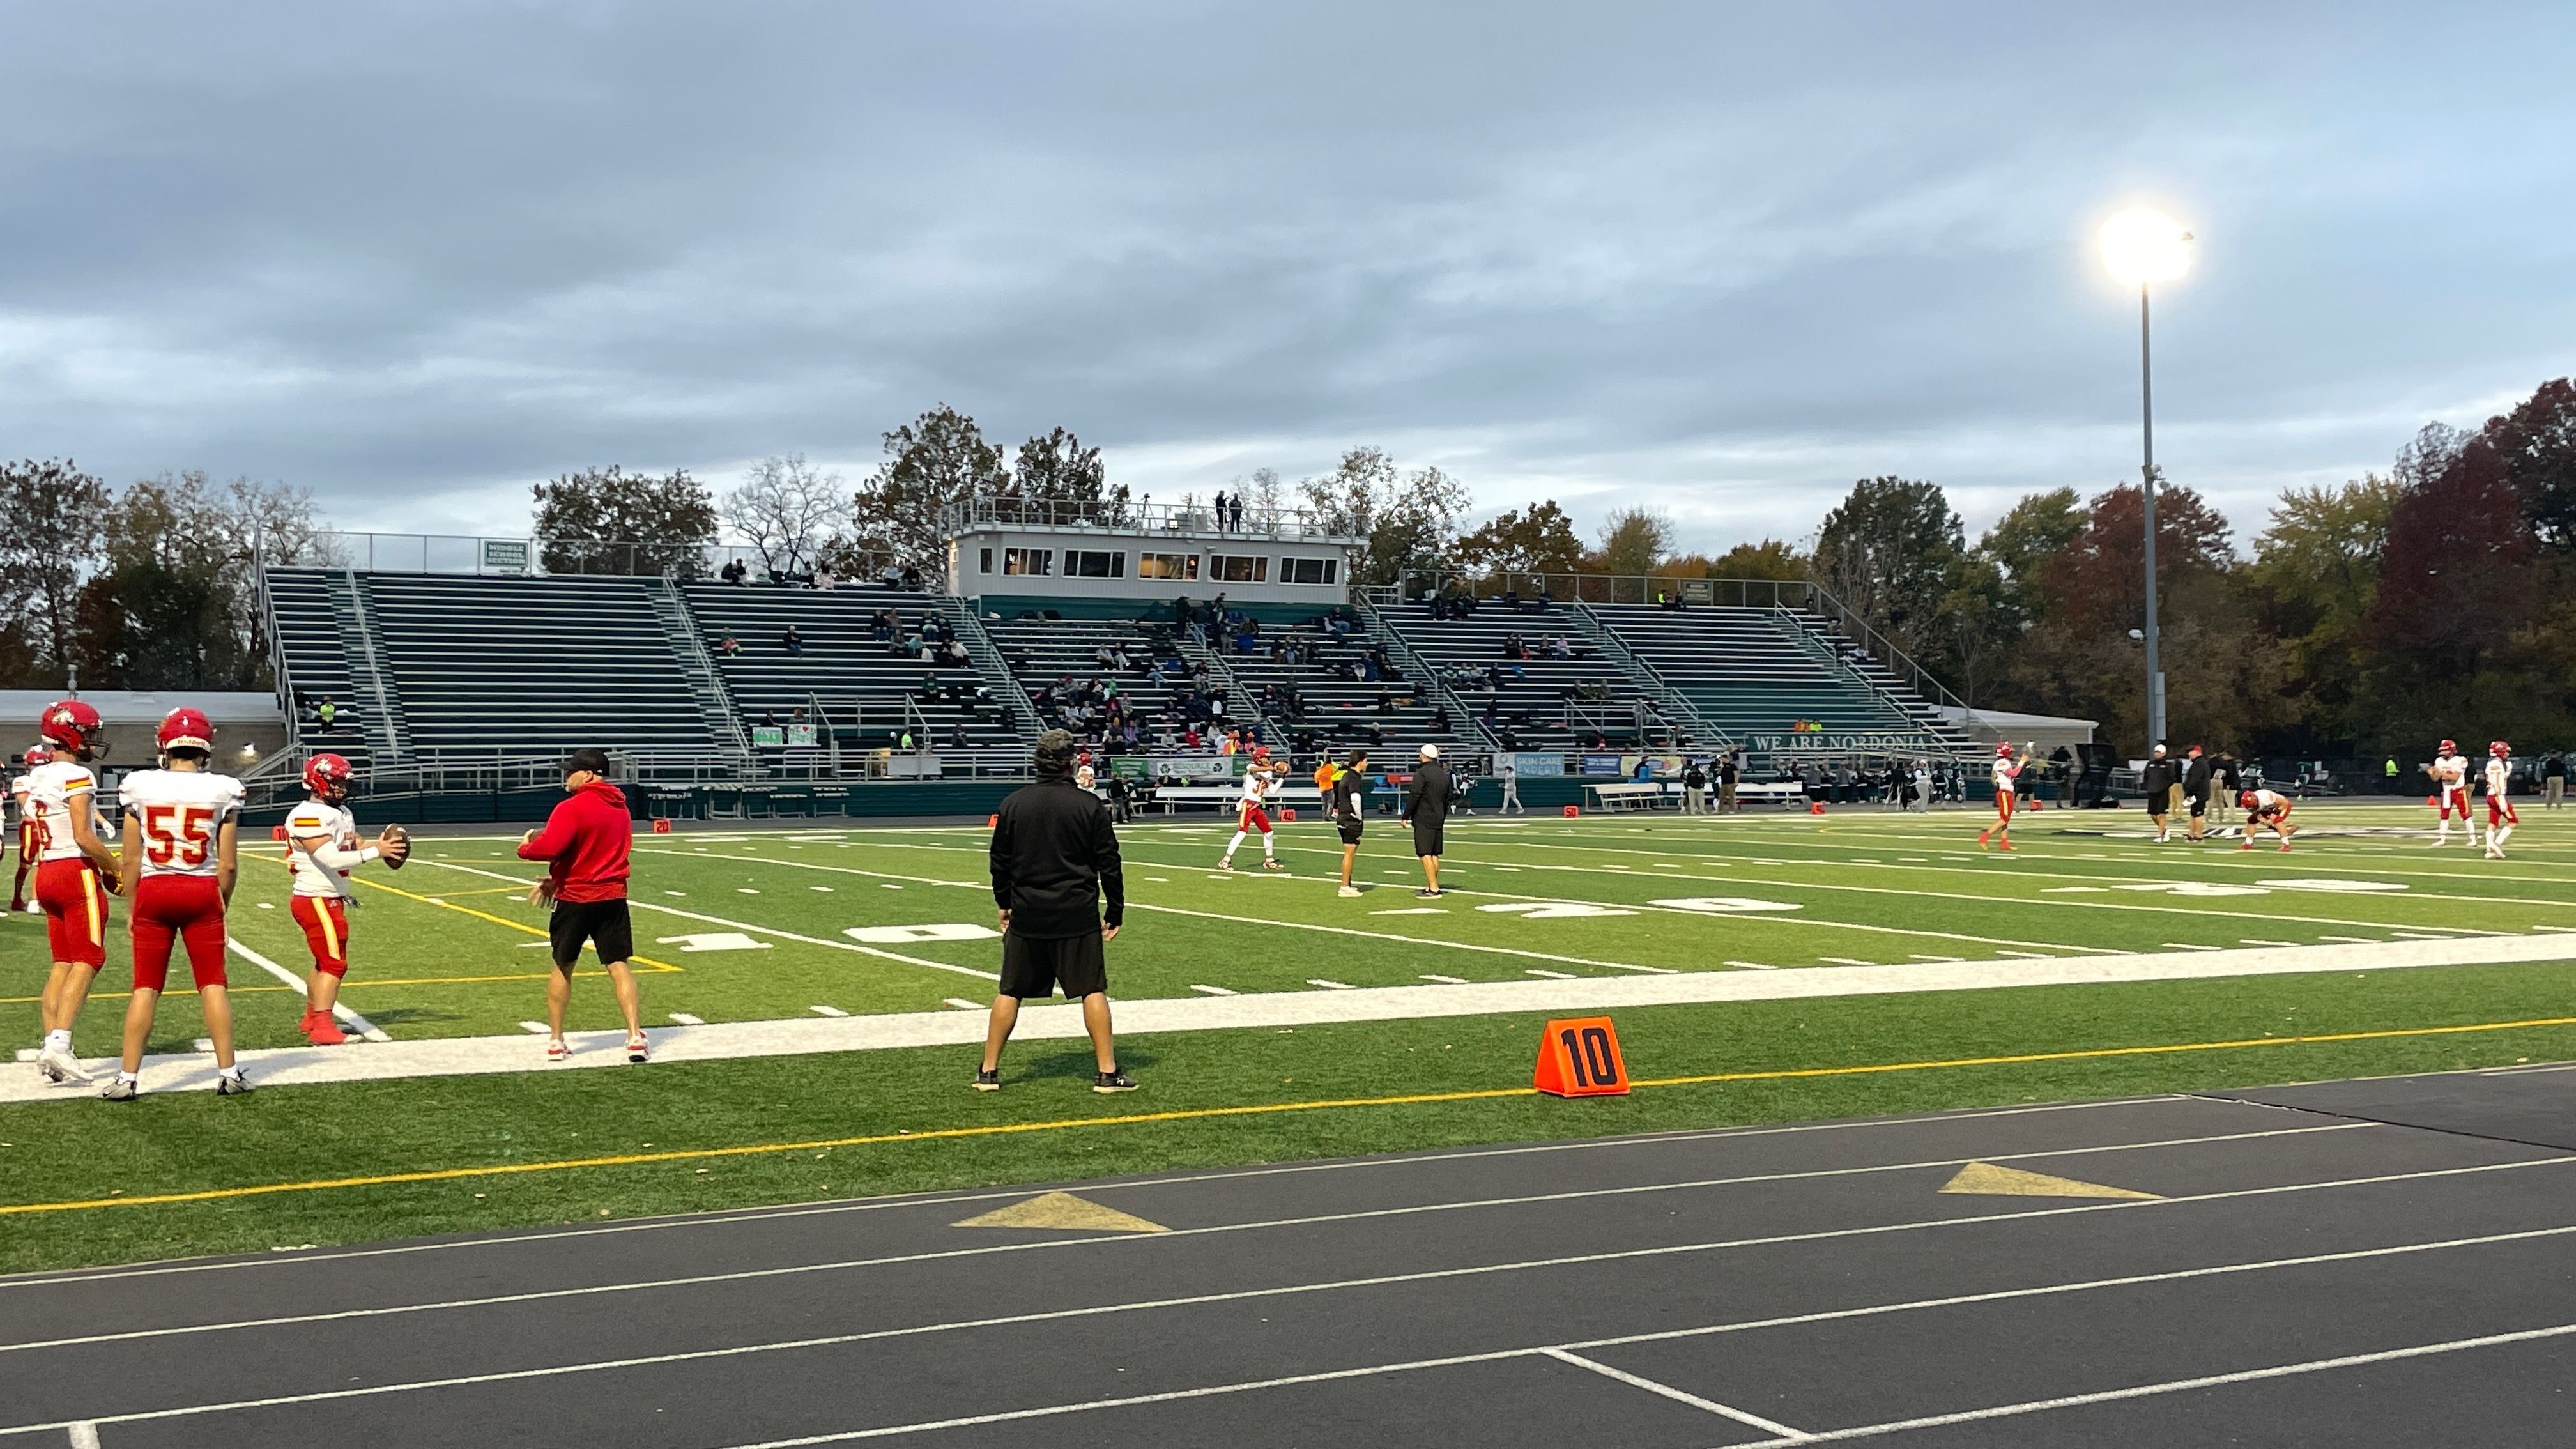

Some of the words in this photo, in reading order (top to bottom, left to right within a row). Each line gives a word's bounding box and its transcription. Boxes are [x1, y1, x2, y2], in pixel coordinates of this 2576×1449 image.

[488, 544, 525, 552] MIDDLE
[1754, 735, 1781, 751] WE
[1789, 735, 1823, 749] ARE
[1829, 735, 1925, 750] NORDONIA
[1517, 756, 1538, 765] SKIN
[1540, 756, 1562, 766] CARE
[1517, 766, 1563, 776] EXPERTS
[1283, 811, 1294, 821] 40
[1566, 808, 1577, 816] 50
[656, 822, 668, 832] 20
[146, 806, 215, 865] 55
[656, 923, 1004, 952] 10
[1561, 1027, 1618, 1087] 10
